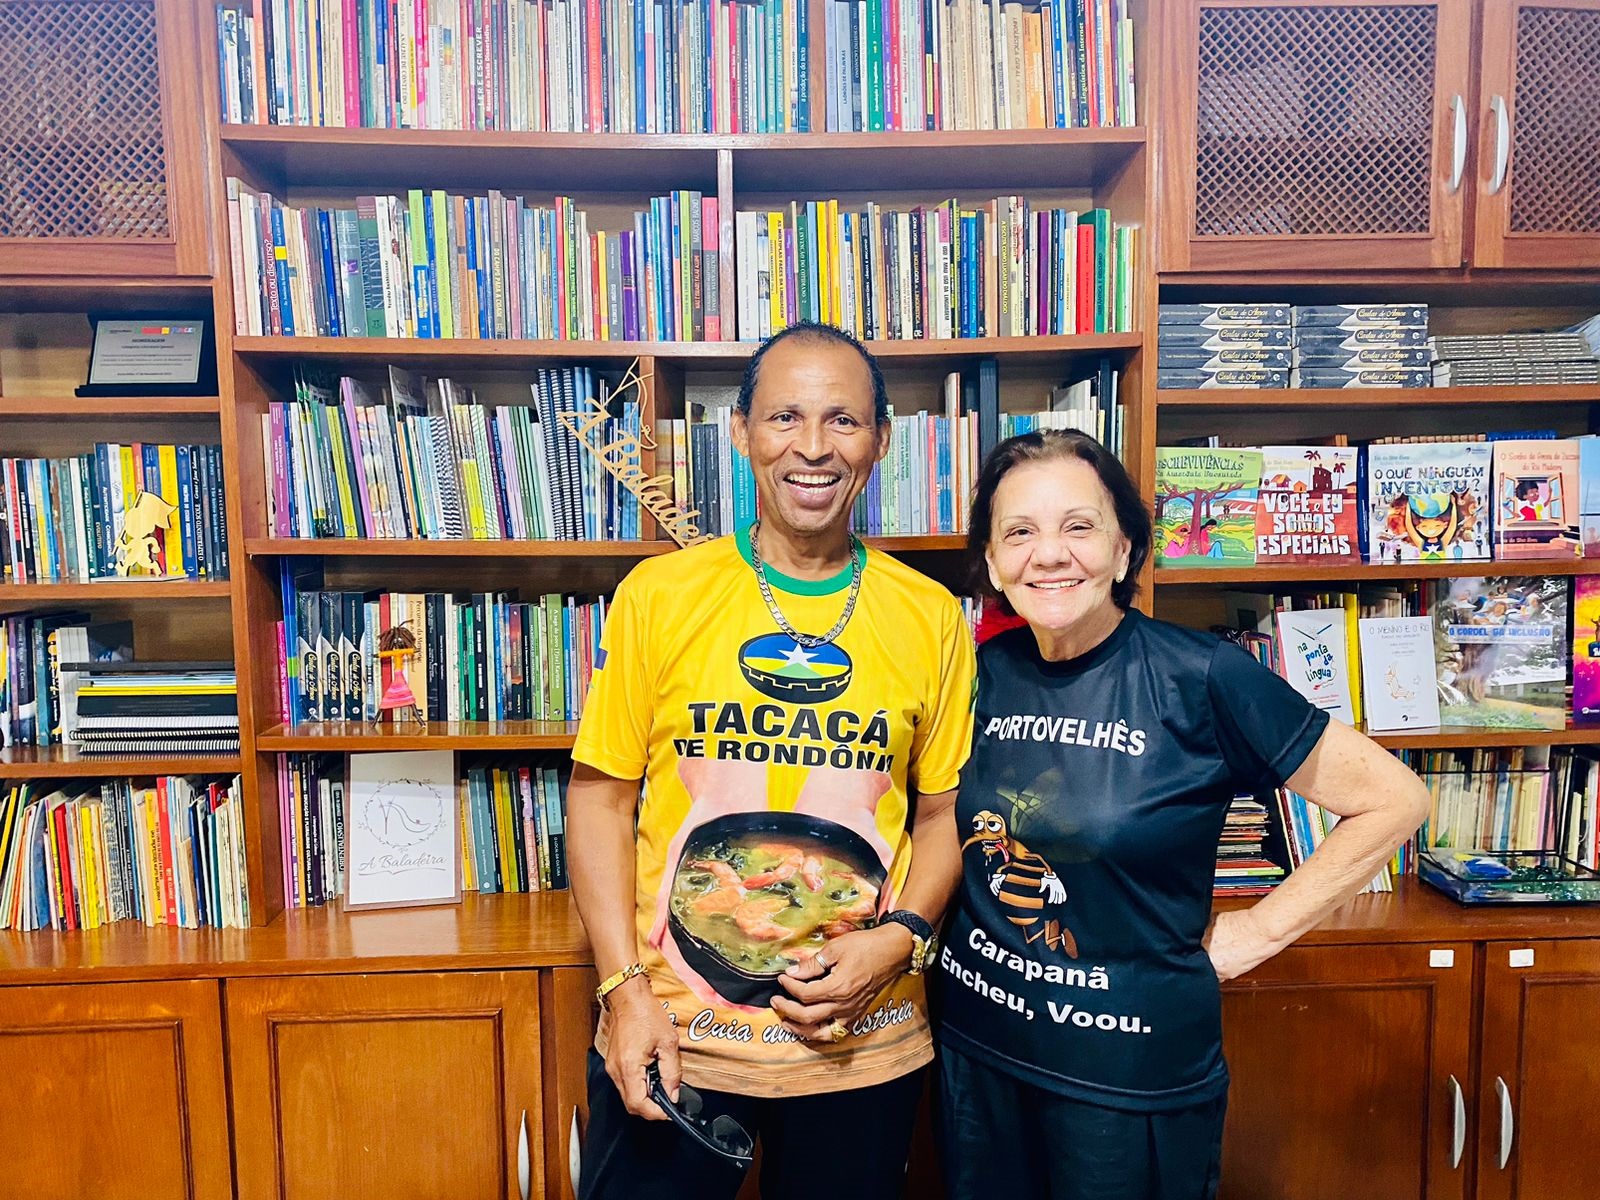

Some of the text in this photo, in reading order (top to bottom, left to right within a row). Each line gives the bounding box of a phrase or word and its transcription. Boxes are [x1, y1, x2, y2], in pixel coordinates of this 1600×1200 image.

[475, 26, 483, 77] ESCREVER
[691, 199, 701, 242] MARCOS BAGNO
[264, 239, 279, 312] Texto ou discurso?
[360, 237, 371, 311] DESMASCARADO
[367, 237, 384, 309] BAKHTIN
[1374, 463, 1484, 480] O QUE NINGUÉM
[1323, 493, 1343, 513] EU
[196, 520, 204, 555] EXPERIMENTO
[1273, 514, 1335, 534] SOMOS
[1258, 535, 1351, 556] ESPECIAIS
[1297, 642, 1308, 654] na
[1449, 628, 1455, 637] O
[1457, 627, 1488, 637] CORDEL
[1305, 643, 1329, 667] ponta
[1323, 653, 1334, 667] da
[1305, 668, 1332, 683] língua
[688, 702, 889, 749] TACACÁ
[984, 714, 1147, 757] PORTOVELHÊS
[359, 851, 445, 871] A Baladeira
[968, 928, 1110, 991] Carapanã
[940, 945, 1152, 1034] Encheu, Voou.
[688, 1008, 753, 1043] Cuia
